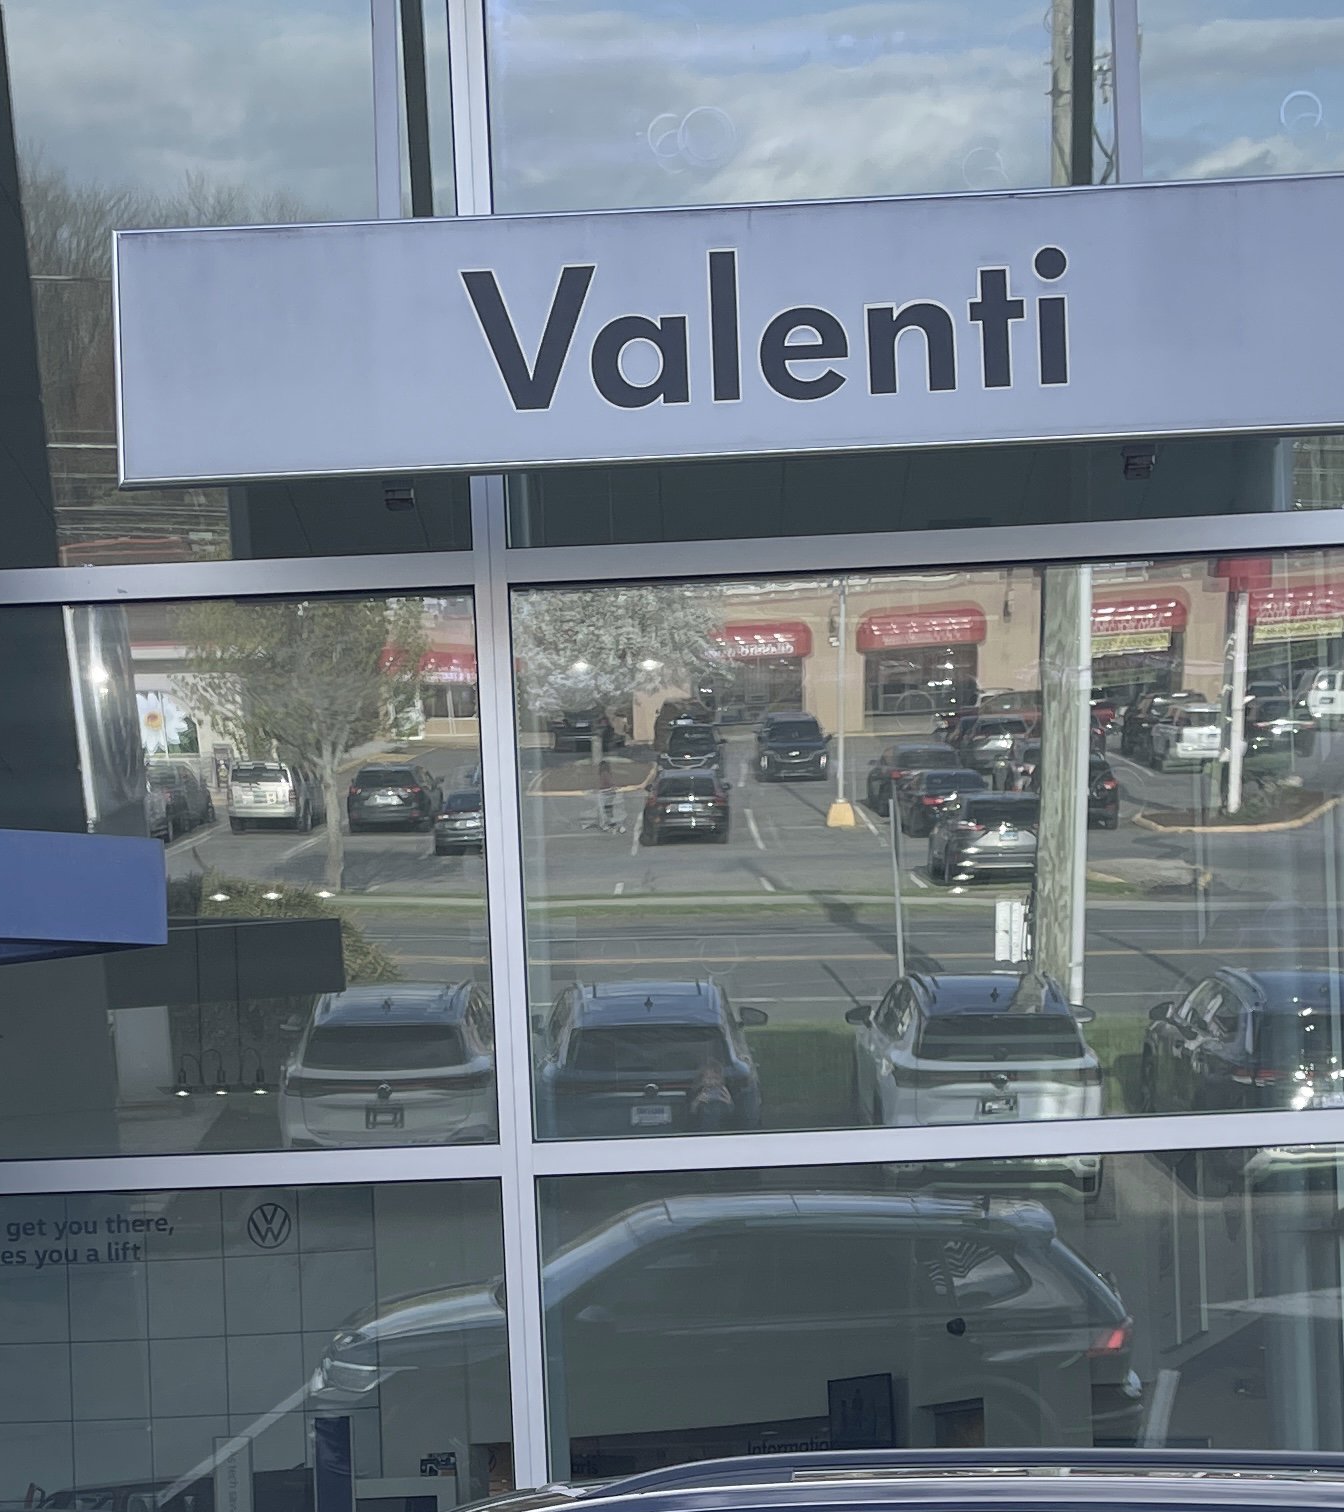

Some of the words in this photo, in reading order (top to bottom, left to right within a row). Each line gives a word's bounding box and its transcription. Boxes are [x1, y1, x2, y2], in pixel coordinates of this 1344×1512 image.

[459, 245, 1069, 412] Valenti
[6, 1219, 47, 1242] get
[53, 1219, 97, 1241] you
[106, 1214, 175, 1236] there,
[35, 1247, 77, 1270] you
[86, 1247, 100, 1262] a
